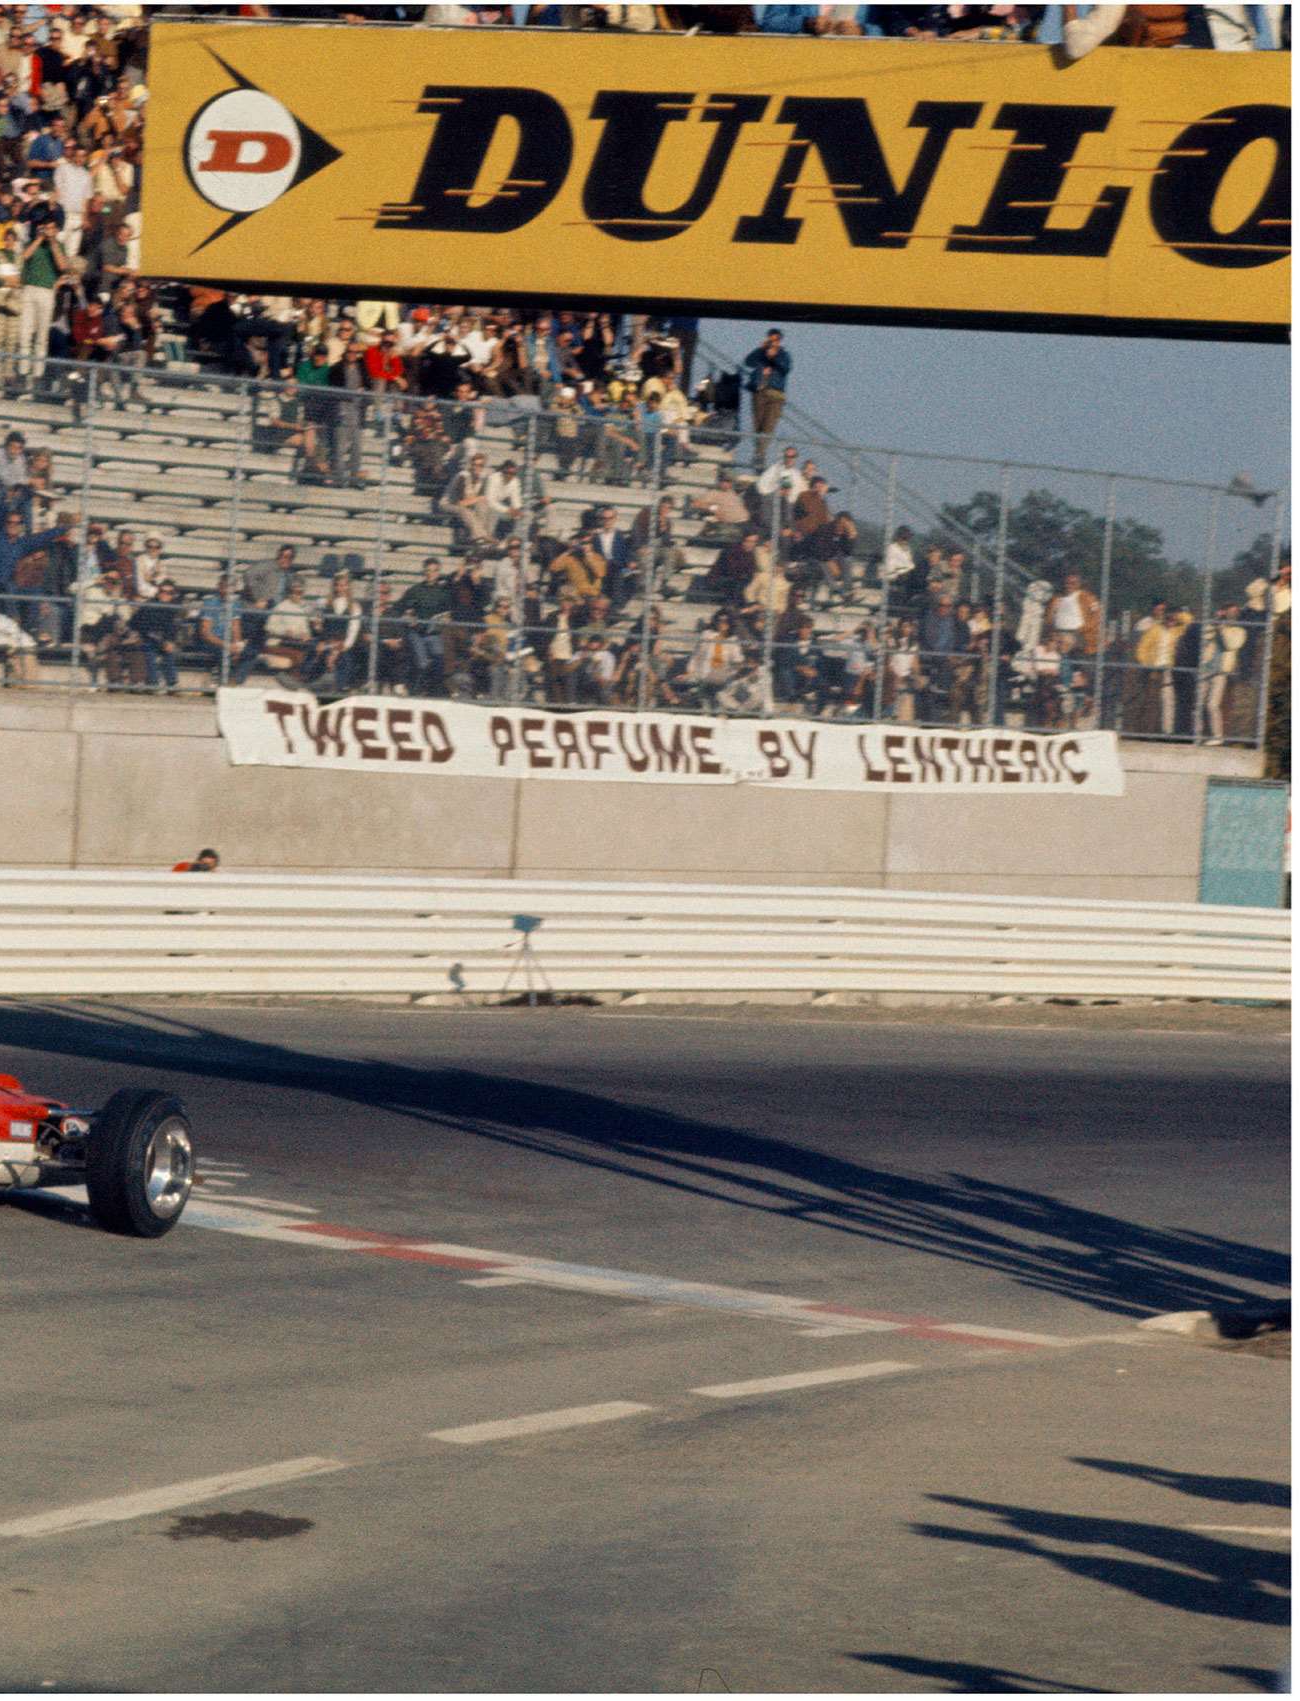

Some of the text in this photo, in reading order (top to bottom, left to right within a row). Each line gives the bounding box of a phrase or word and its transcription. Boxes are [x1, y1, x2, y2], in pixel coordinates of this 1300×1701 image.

[373, 84, 1292, 269] DUNLO
[266, 701, 1090, 784] TWEED PERFUME BY LENTHERIC
